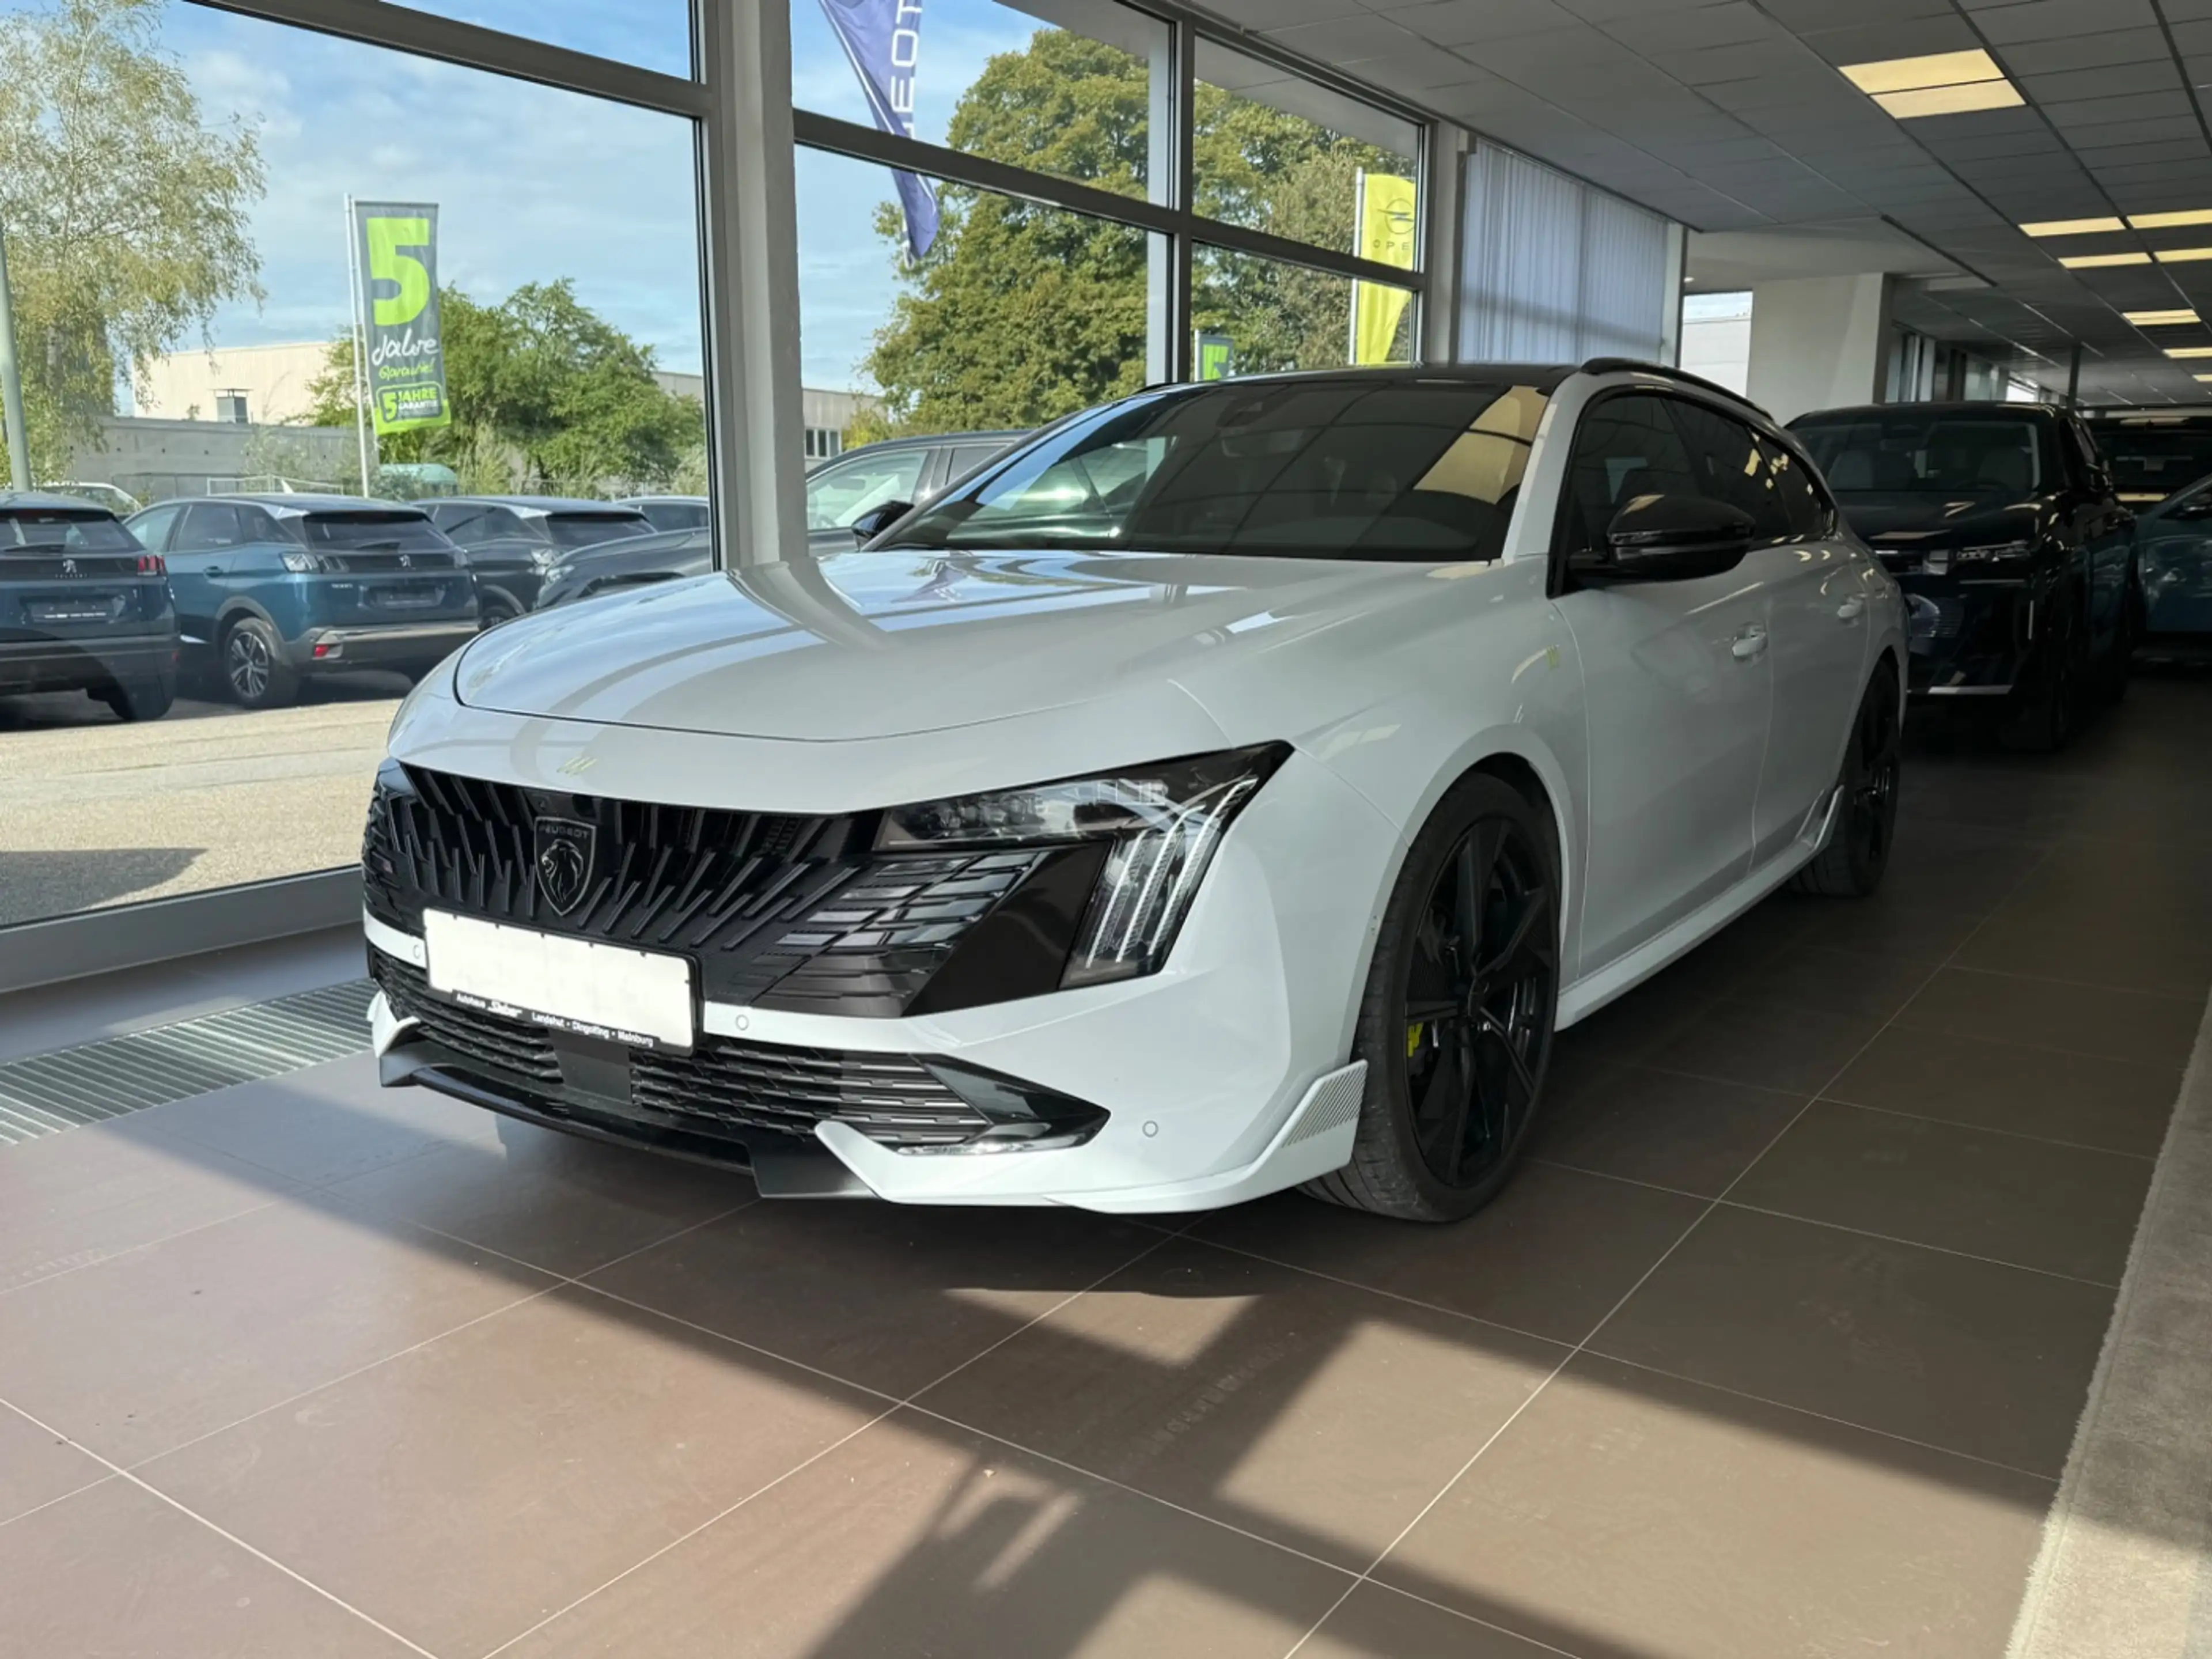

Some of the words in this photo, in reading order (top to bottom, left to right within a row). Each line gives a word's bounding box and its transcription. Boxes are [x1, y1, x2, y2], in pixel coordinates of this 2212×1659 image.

[368, 218, 429, 325] 5
[372, 328, 440, 366] Jahre
[398, 388, 437, 402] JAHRE
[539, 825, 589, 839] PEUGEOT
